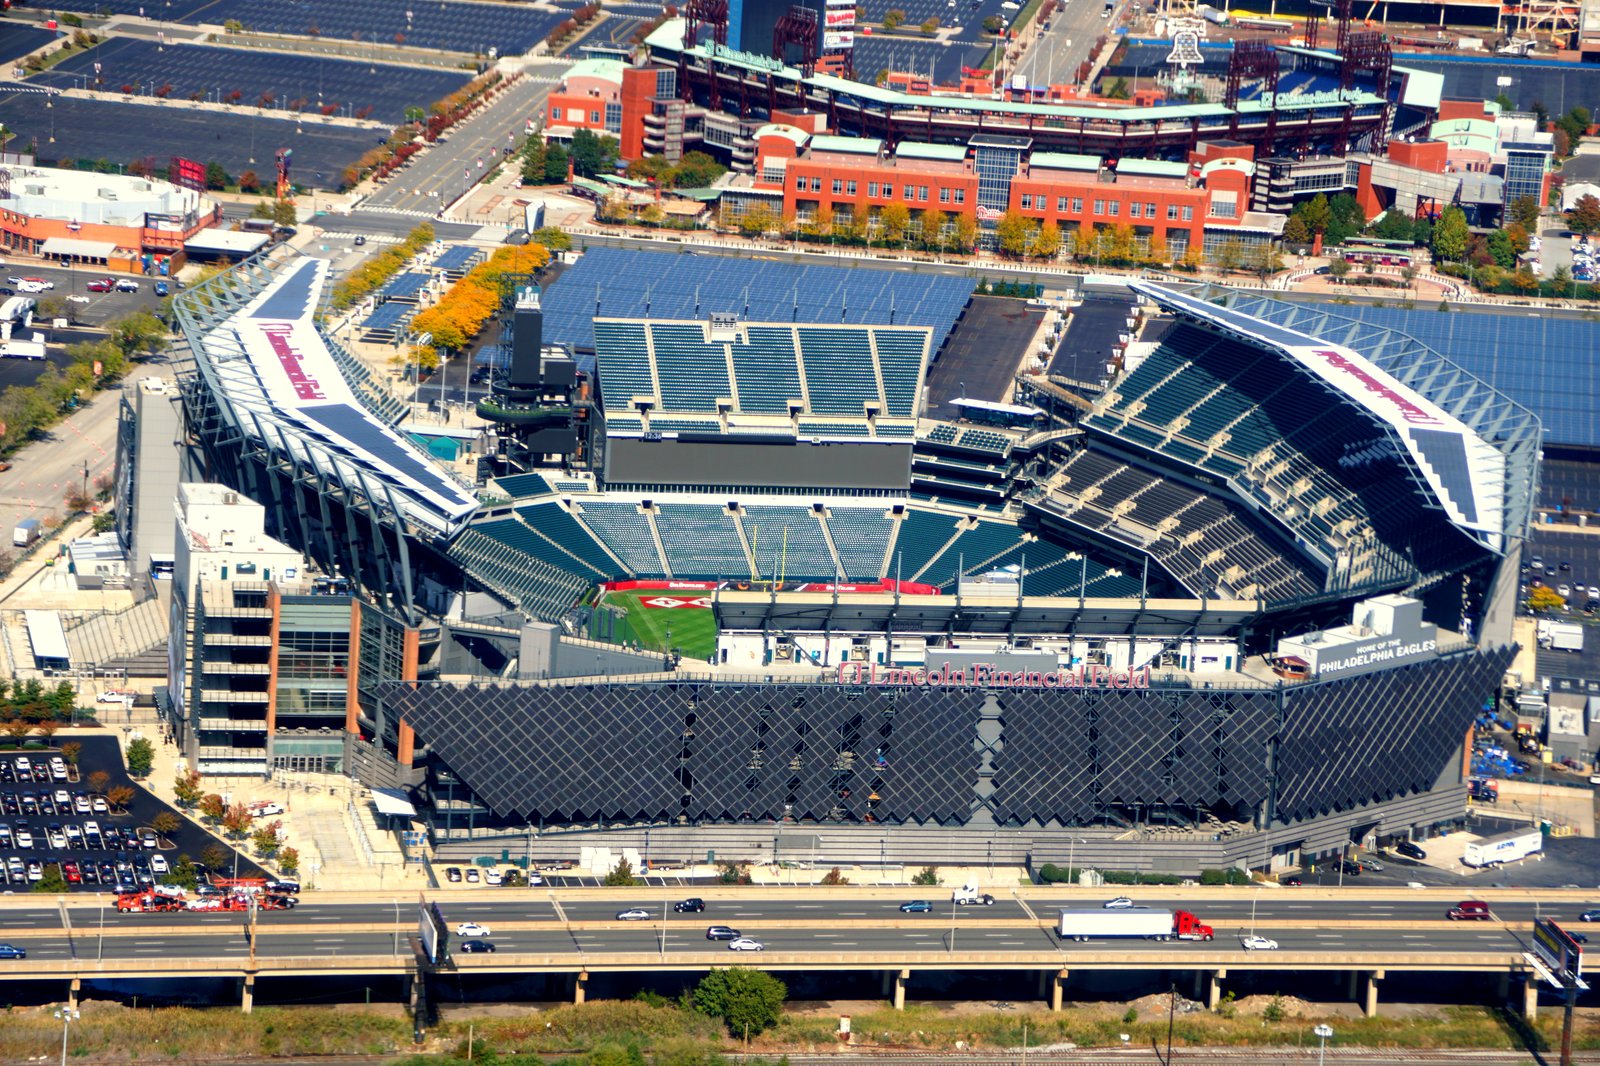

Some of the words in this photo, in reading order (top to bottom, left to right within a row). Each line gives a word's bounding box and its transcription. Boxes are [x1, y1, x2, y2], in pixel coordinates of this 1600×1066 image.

[1319, 649, 1395, 673] PHILADELPHIA
[1396, 640, 1436, 657] EAGLES
[1356, 644, 1376, 655] HOME
[1377, 642, 1386, 651] OF
[1388, 639, 1401, 649] THE
[867, 661, 967, 686] Lincoln
[970, 662, 1086, 688] Financial
[1088, 663, 1150, 689] Field
